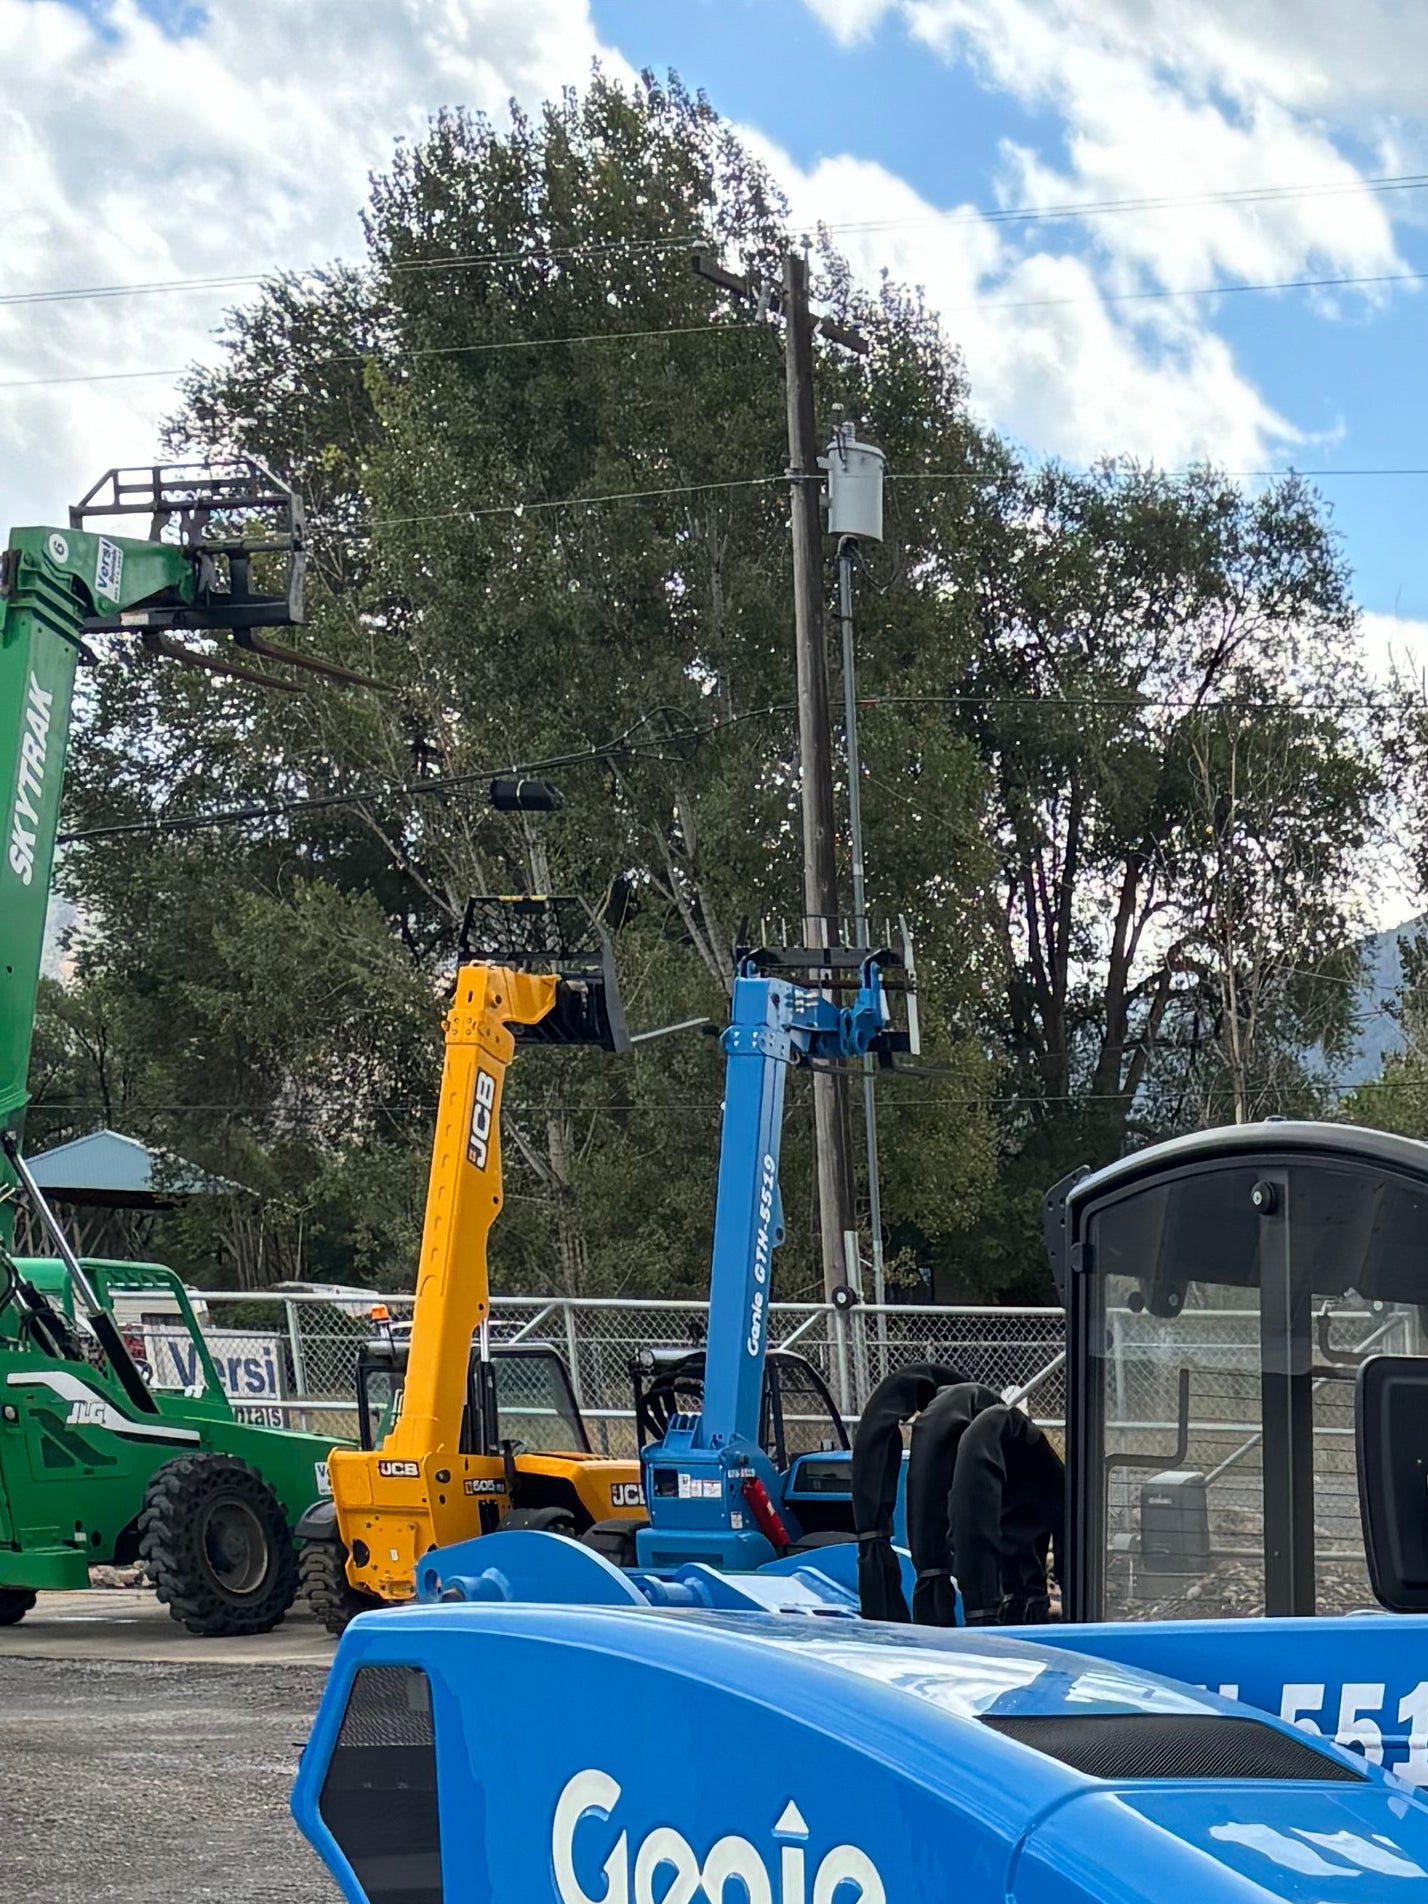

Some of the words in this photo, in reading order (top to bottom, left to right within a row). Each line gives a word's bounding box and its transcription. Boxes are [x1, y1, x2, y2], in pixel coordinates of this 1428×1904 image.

[9, 670, 53, 886] SKYTRAK
[470, 1070, 496, 1169] JCB
[754, 1154, 776, 1285] GTH-5519
[747, 1292, 764, 1357] Genie
[66, 1402, 105, 1424] JLG
[380, 1463, 419, 1476] JCB
[612, 1484, 646, 1506] JC
